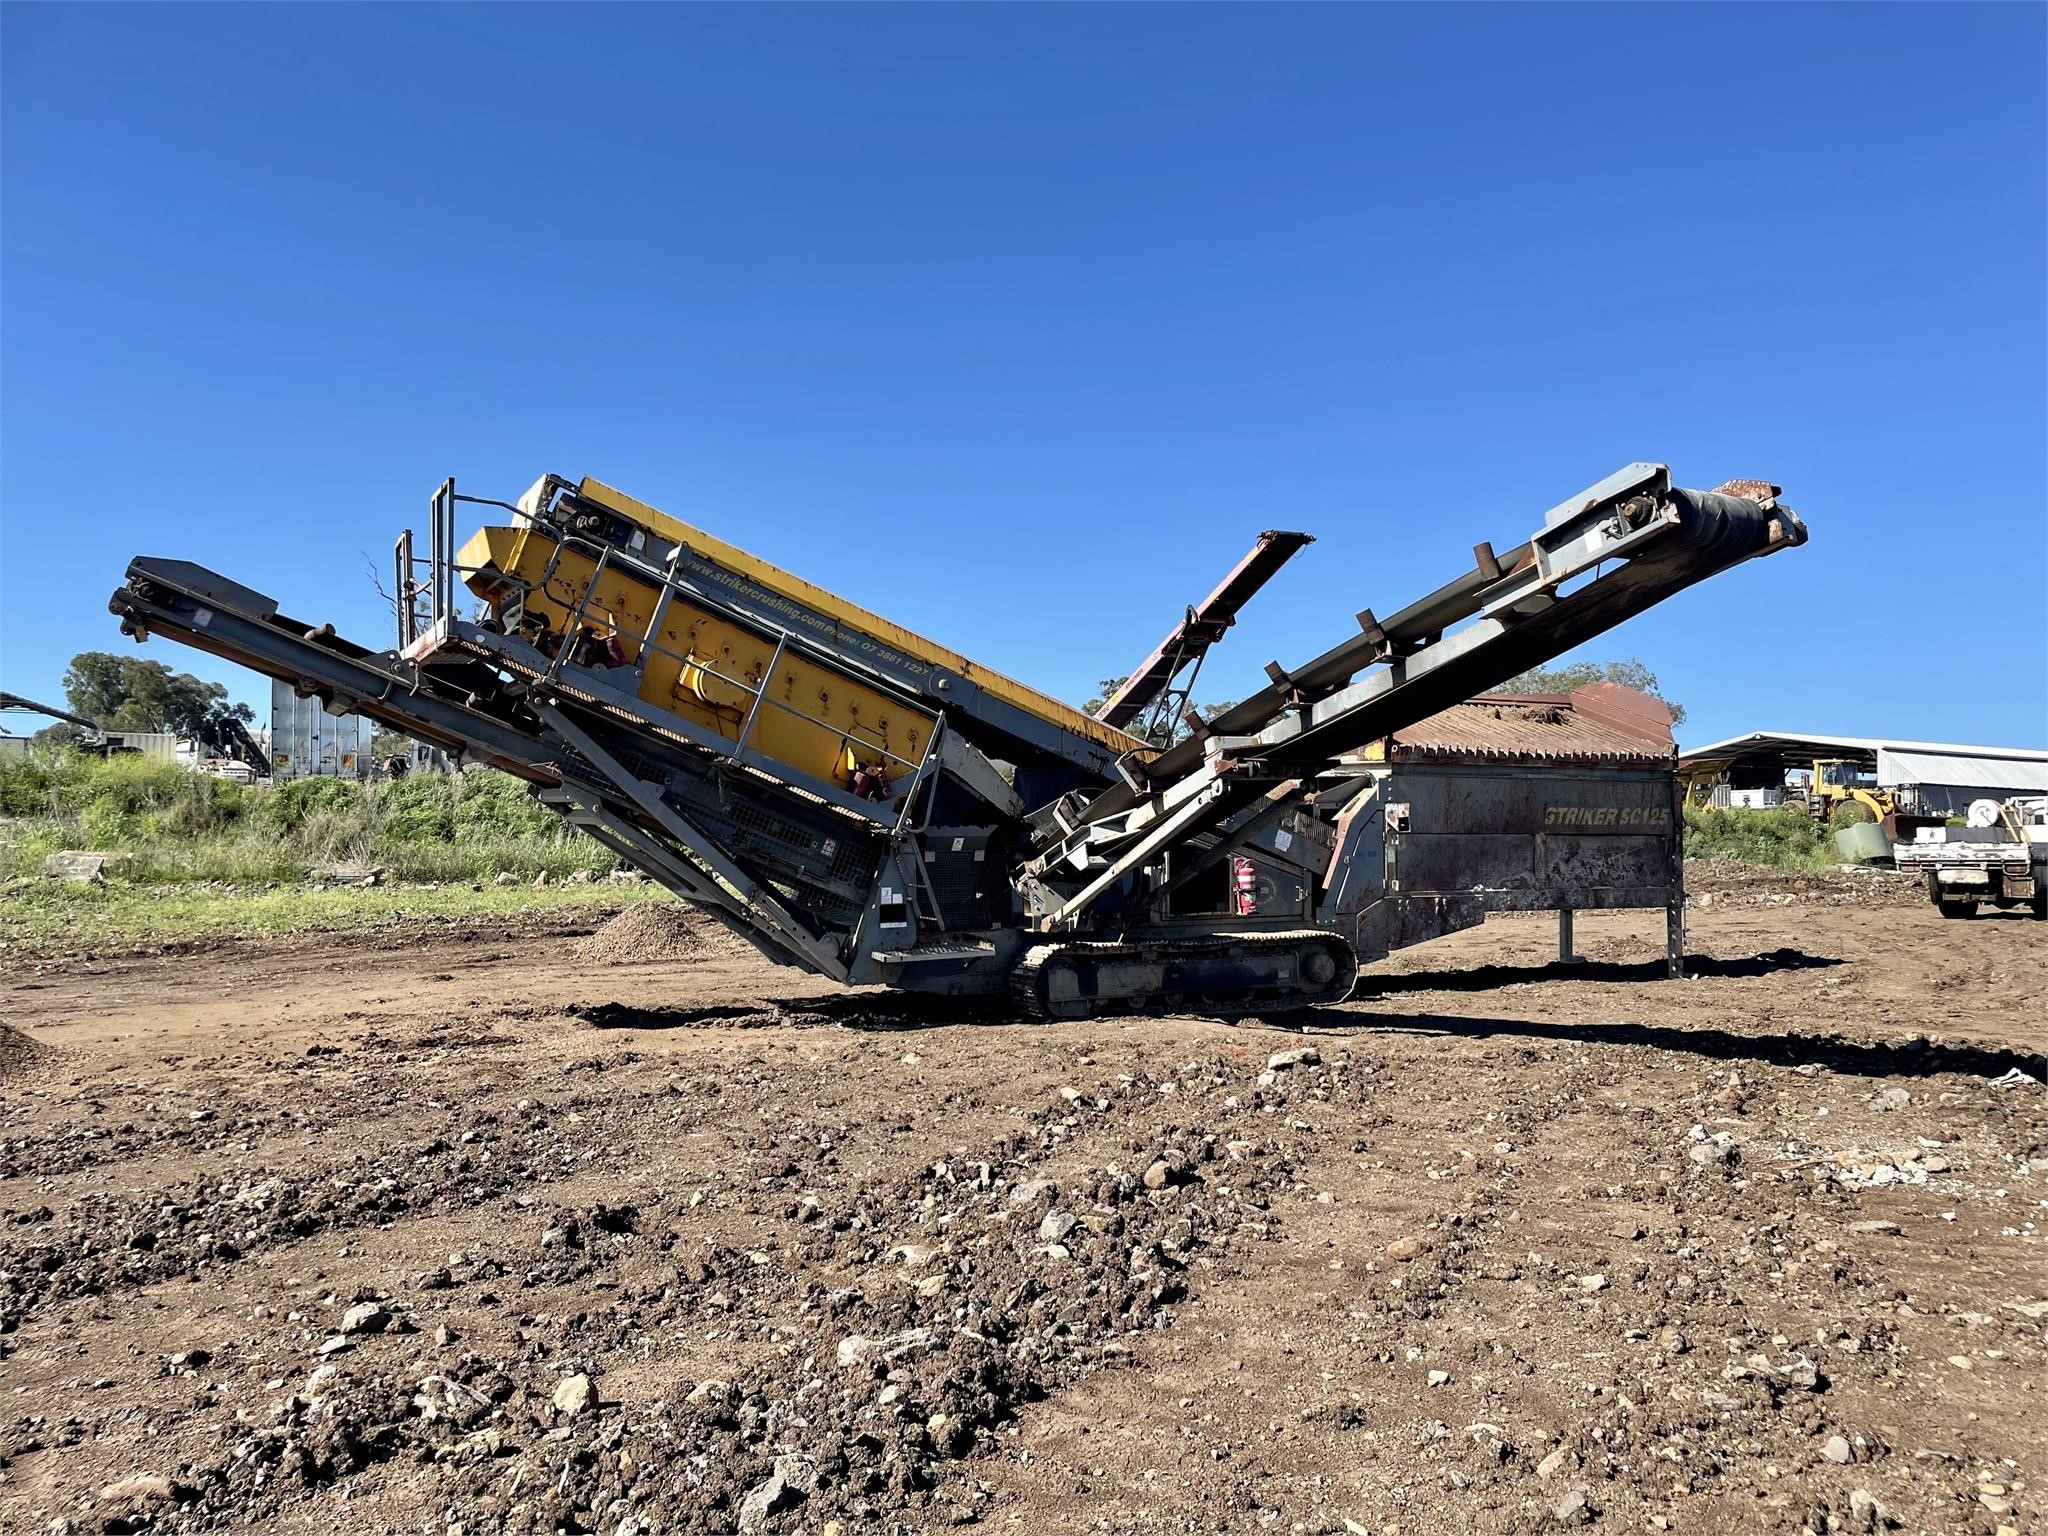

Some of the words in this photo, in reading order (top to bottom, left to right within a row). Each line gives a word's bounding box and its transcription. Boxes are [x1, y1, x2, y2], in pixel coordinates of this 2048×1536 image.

[824, 626, 859, 646] Phone:
[861, 642, 878, 653] 07
[877, 649, 902, 665] 3881
[1544, 806, 1618, 826] STRIKER
[1620, 807, 1671, 826] SC125
